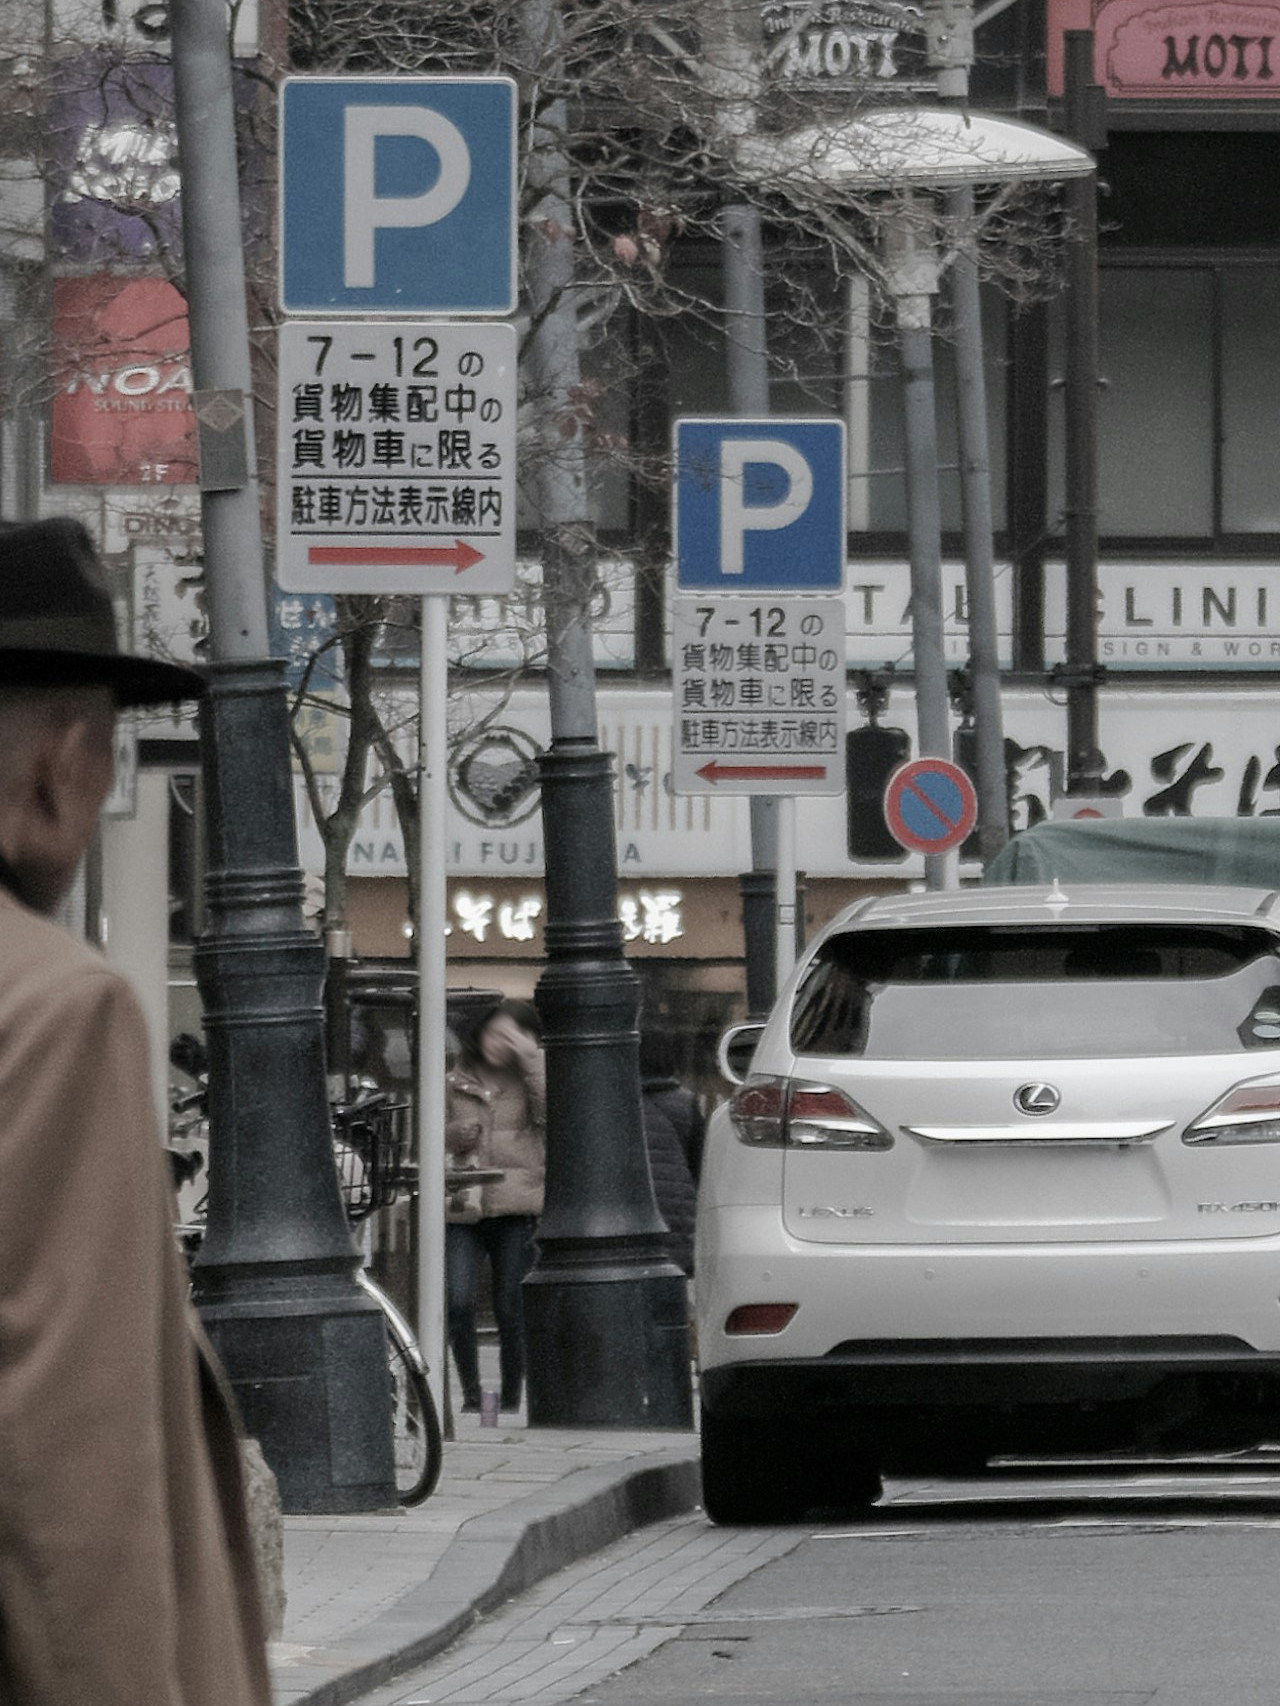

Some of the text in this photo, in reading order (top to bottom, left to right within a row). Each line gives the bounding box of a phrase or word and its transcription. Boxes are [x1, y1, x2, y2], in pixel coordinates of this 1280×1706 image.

[784, 31, 898, 77] MOTI
[1162, 34, 1275, 79] MOTI
[345, 106, 471, 288] P
[291, 383, 502, 425] 貨物集配中の
[291, 430, 502, 471] 貨物車に限る
[291, 486, 502, 527] 駐車方法表示線内
[721, 440, 814, 574] P
[681, 644, 838, 674] 貨物集配中の
[681, 678, 838, 708] 貨物車に限る
[681, 719, 838, 750] 駐車方法表示線内
[799, 1206, 875, 1219] LEXUS
